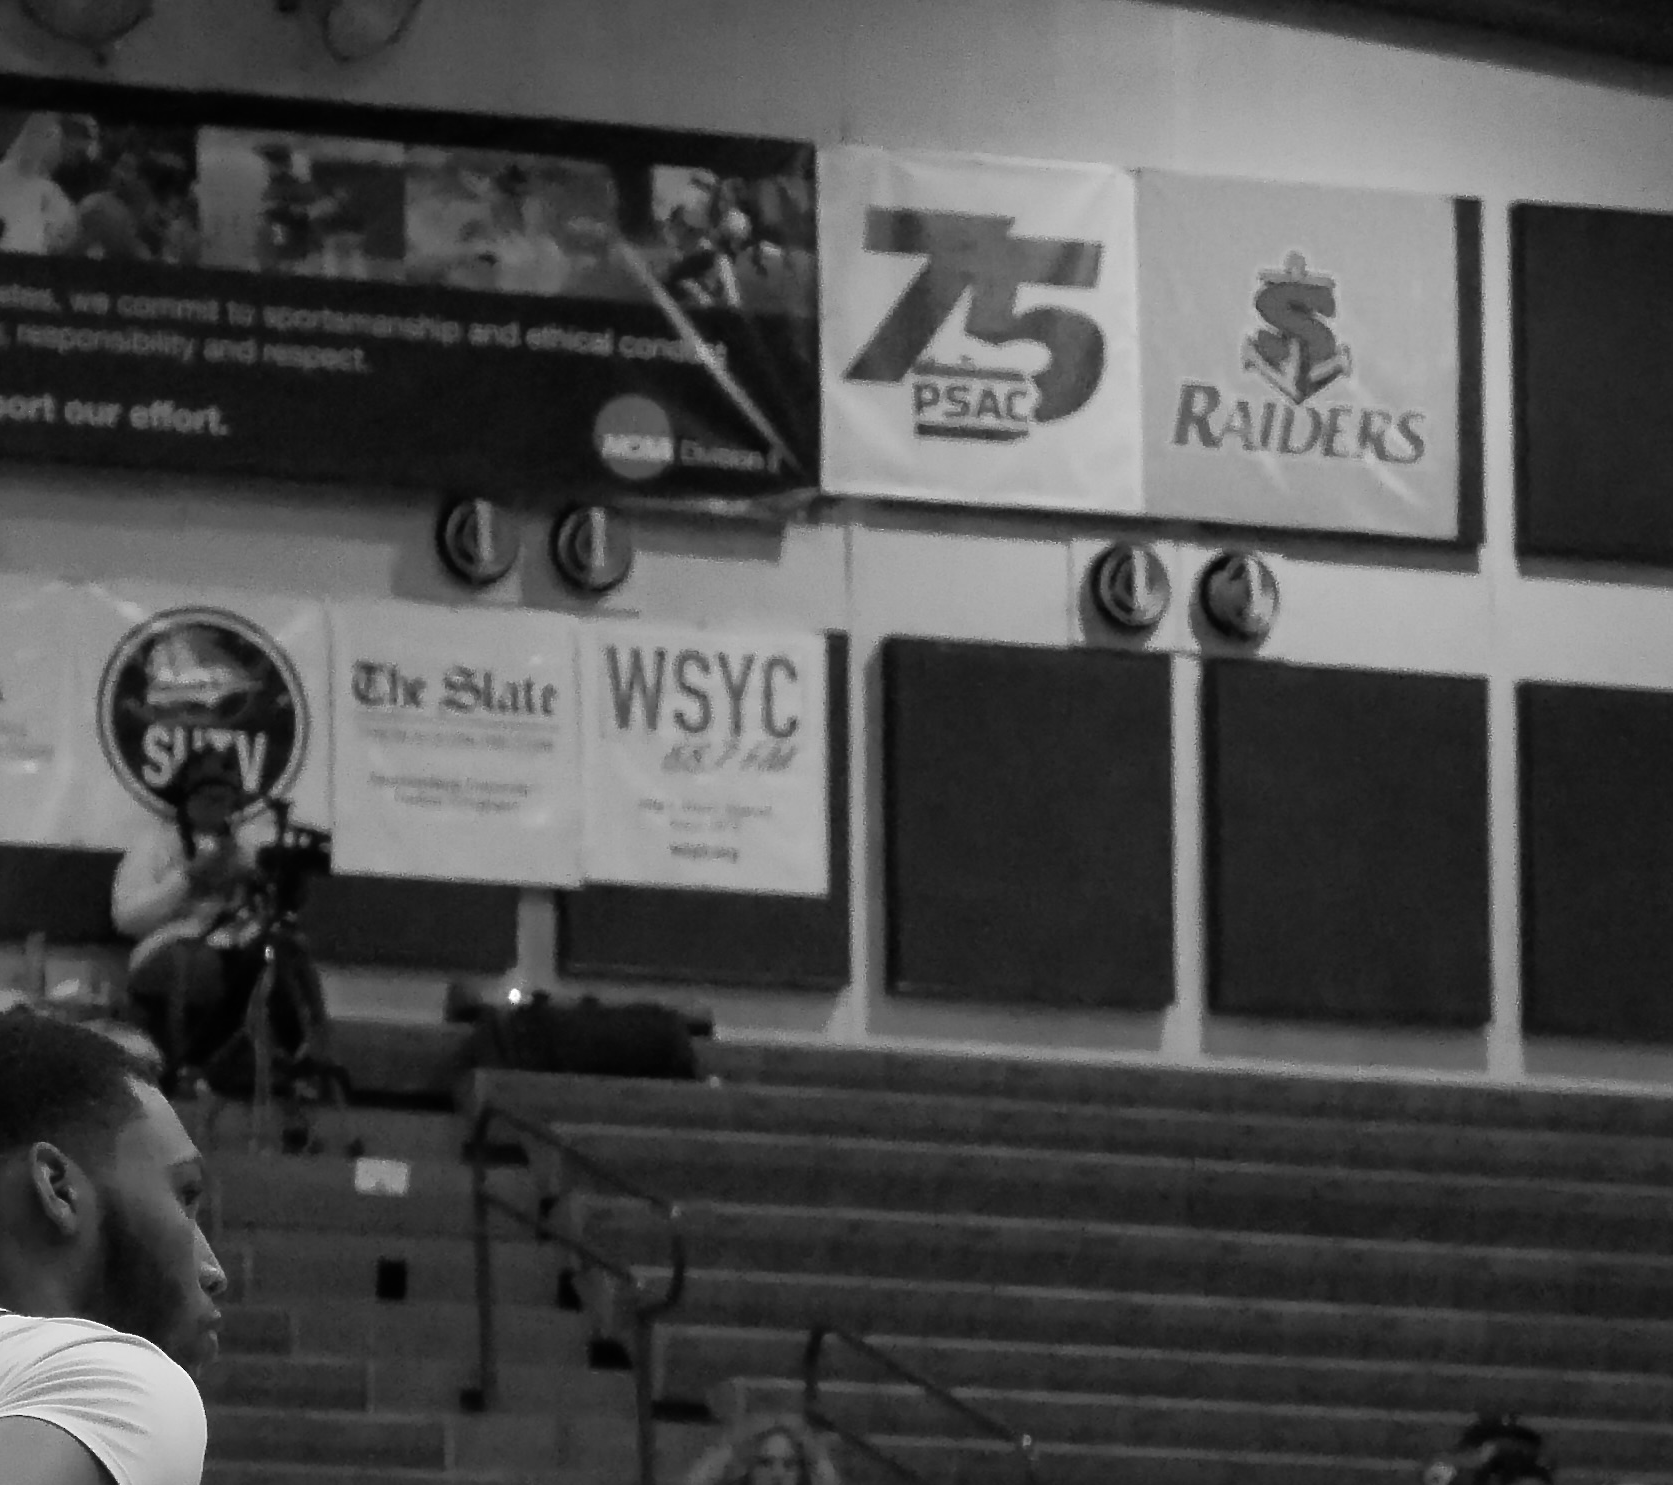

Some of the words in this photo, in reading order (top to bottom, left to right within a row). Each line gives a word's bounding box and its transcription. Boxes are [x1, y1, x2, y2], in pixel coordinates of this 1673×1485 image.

[843, 205, 1105, 424] 75
[64, 398, 123, 428] our
[913, 381, 1029, 423] PSAC
[1173, 381, 1426, 464] RAIDERS
[604, 646, 800, 739] WSYC
